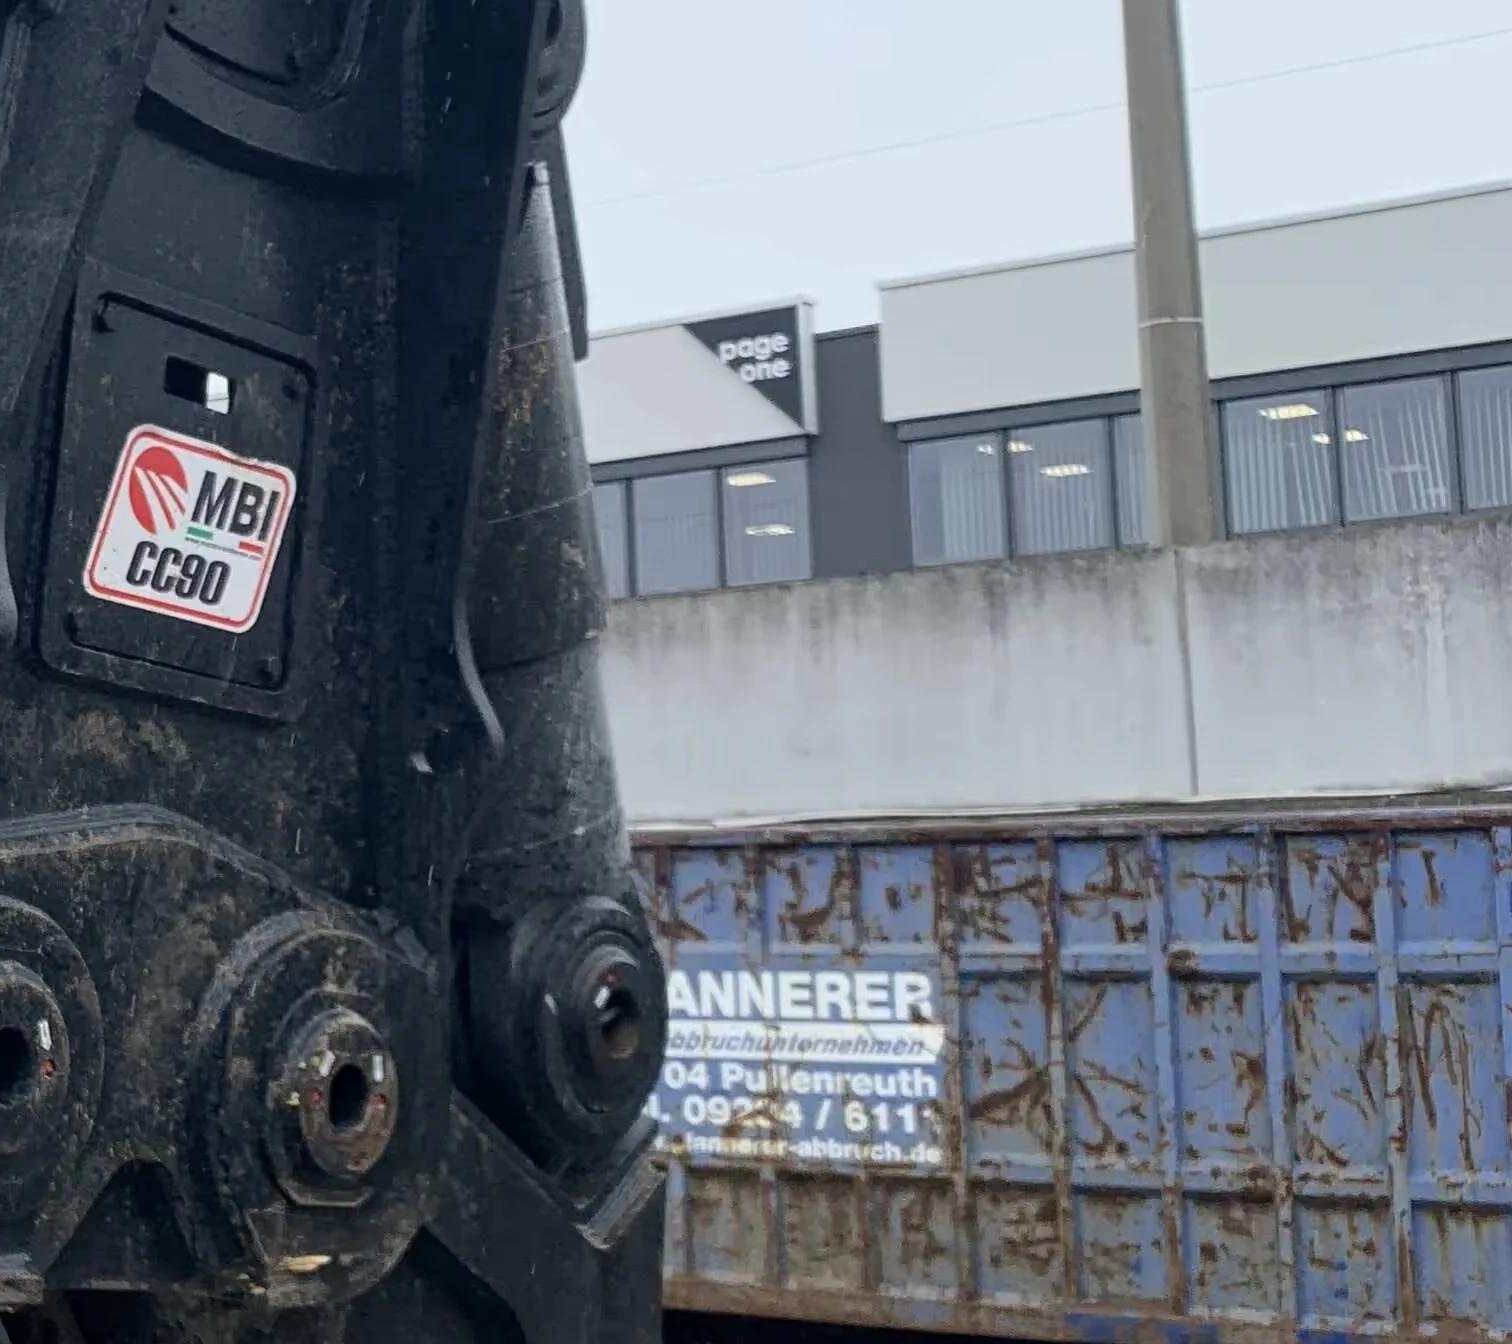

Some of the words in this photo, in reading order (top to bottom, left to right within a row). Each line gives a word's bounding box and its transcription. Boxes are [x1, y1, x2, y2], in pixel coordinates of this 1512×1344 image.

[718, 332, 790, 364] page
[740, 357, 791, 383] one
[191, 469, 281, 542] MBI
[125, 540, 231, 606] CC90
[667, 970, 933, 1021] ANNERER
[664, 1061, 710, 1090] 04
[720, 1062, 937, 1098] Pullenreuth
